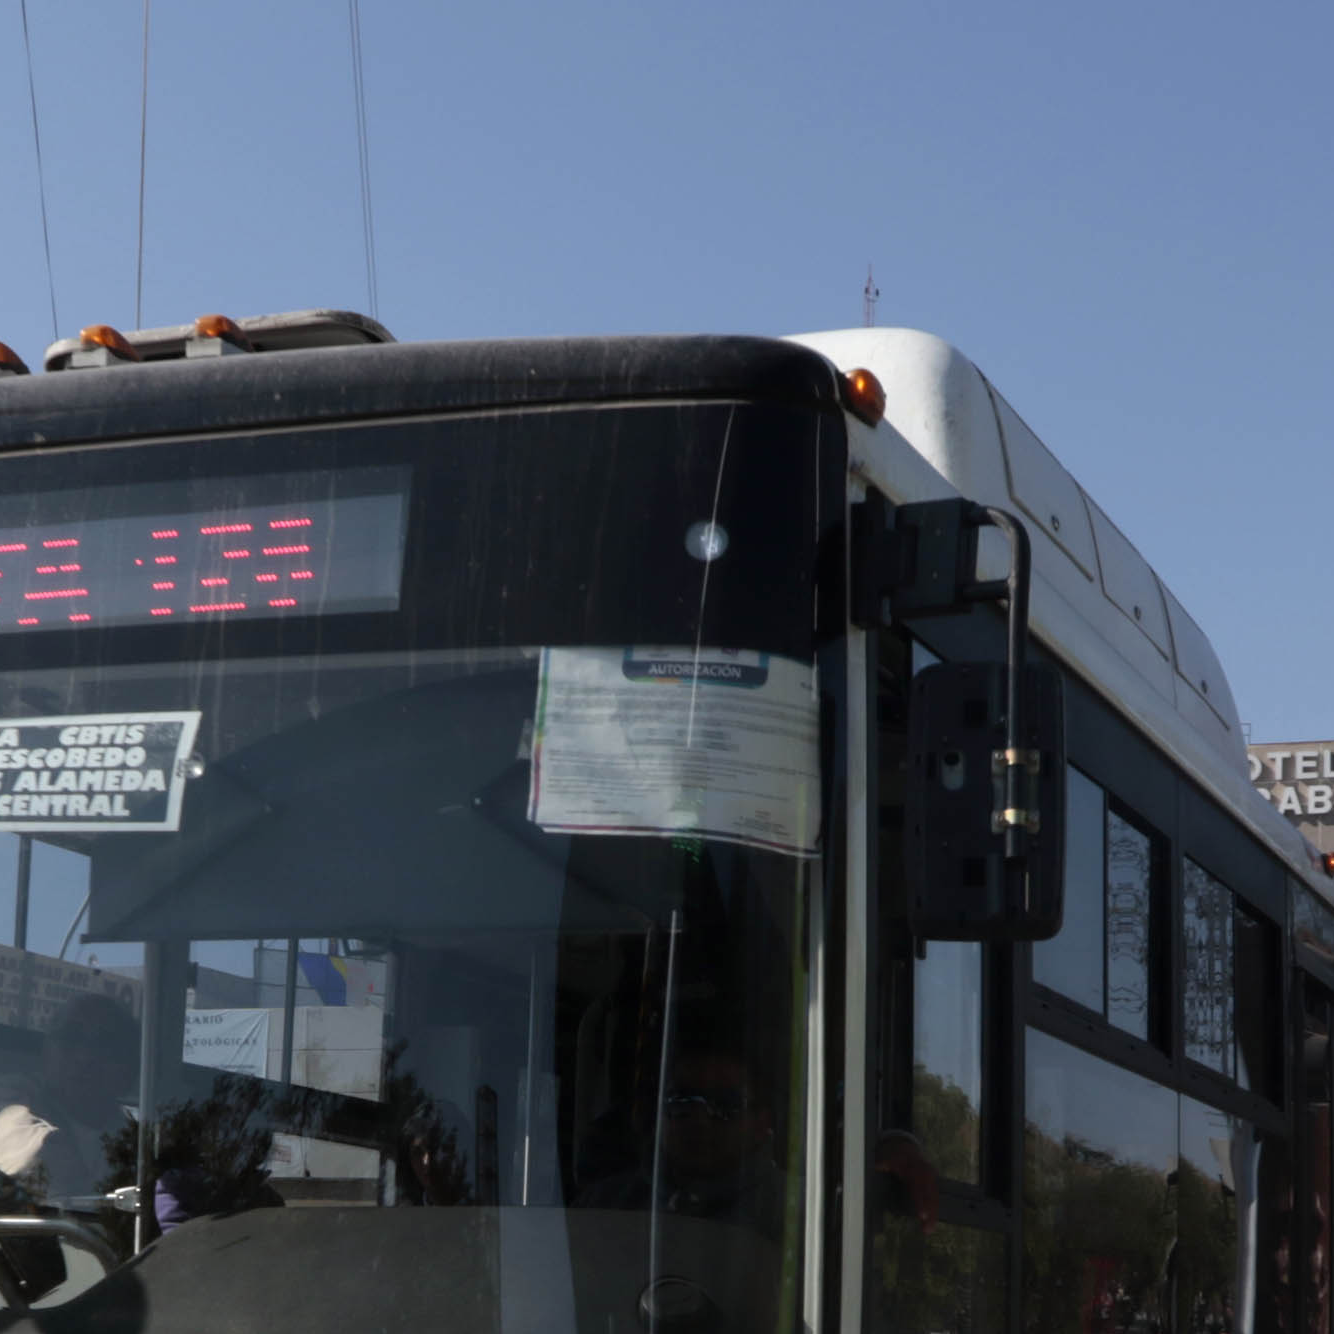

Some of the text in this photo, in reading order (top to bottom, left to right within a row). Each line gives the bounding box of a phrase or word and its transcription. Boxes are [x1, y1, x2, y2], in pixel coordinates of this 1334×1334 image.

[647, 660, 743, 680] AUTORIZACIÓN
[58, 724, 146, 746] CBTIS
[13, 768, 166, 793] ALAMEDA
